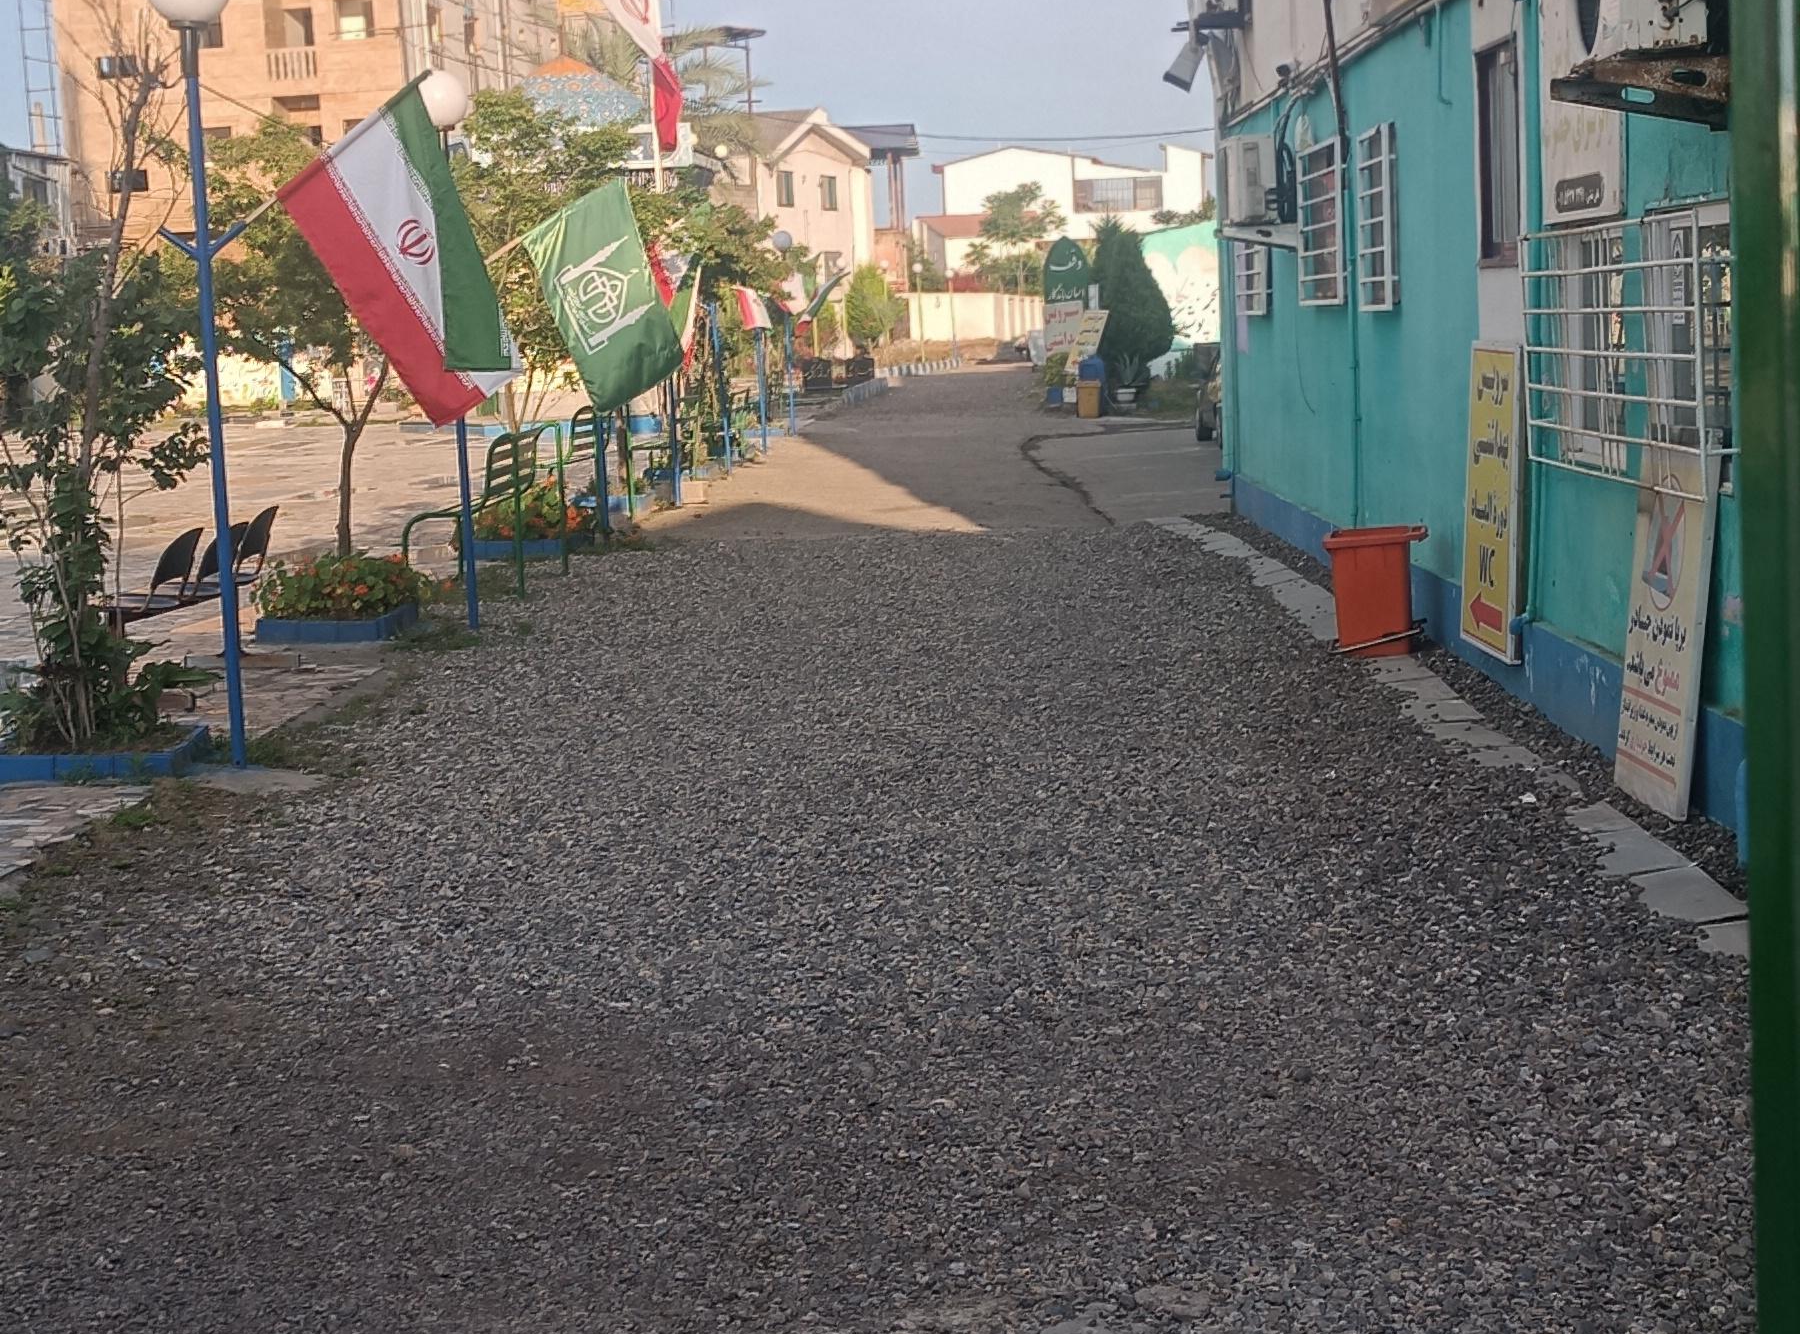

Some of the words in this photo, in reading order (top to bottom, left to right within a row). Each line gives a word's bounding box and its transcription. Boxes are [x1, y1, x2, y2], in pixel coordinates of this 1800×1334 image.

[1048, 249, 1083, 272] وقف
[1044, 309, 1079, 324] سرویس
[1045, 331, 1075, 352] داشتی
[1476, 365, 1510, 407] سرویس
[1472, 418, 1509, 471] بهداشتی
[1479, 544, 1496, 588] WC
[1652, 614, 1675, 647] نمودن
[1674, 616, 1687, 653] برپا
[1643, 665, 1655, 687] می
[1654, 658, 1680, 697] ممنوع
